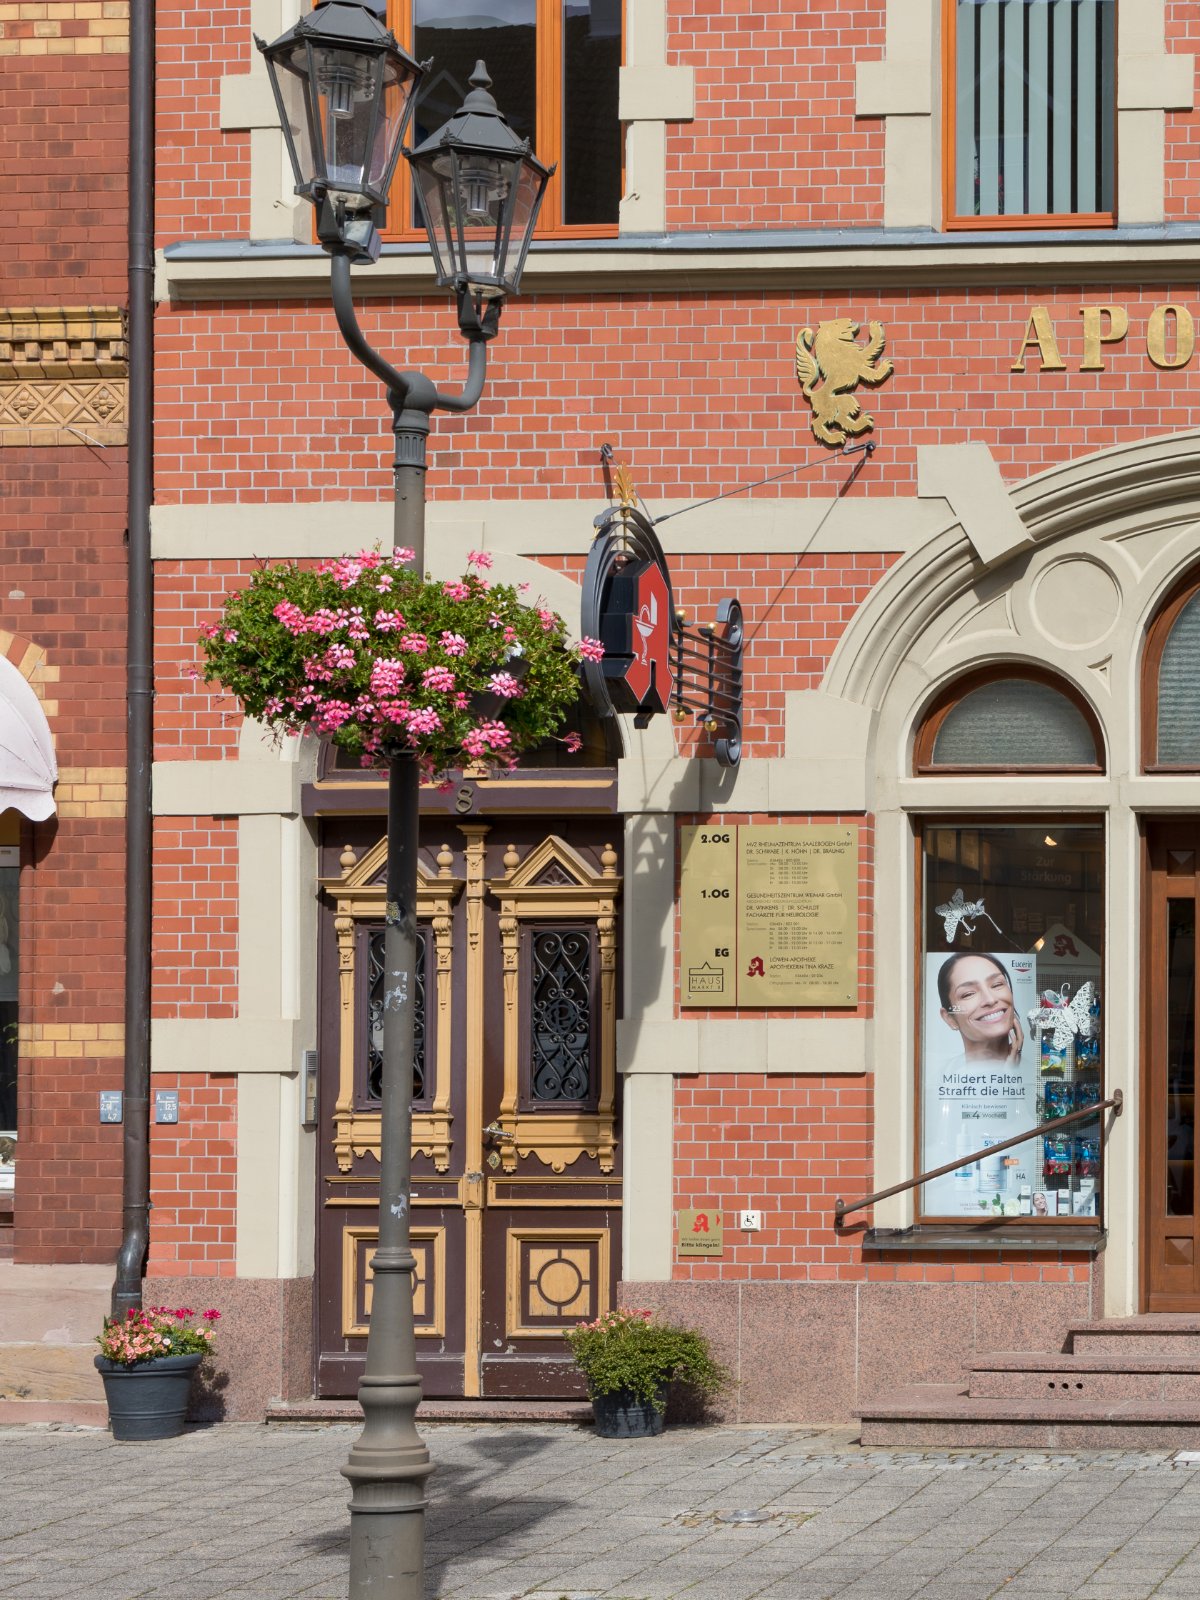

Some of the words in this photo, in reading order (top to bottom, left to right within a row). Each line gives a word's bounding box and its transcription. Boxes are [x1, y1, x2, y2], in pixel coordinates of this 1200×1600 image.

[701, 834, 730, 843] 2.OG
[701, 889, 730, 898] 1.OG
[715, 948, 730, 957] EG
[1011, 960, 1032, 968] Eucerin
[691, 976, 721, 984] HAUS
[942, 1074, 987, 1084] Mildert
[990, 1074, 1023, 1084] Falten
[938, 1086, 977, 1096] Strafft
[980, 1086, 999, 1096] die
[1002, 1086, 1026, 1096] Haut
[972, 1110, 981, 1119] 4
